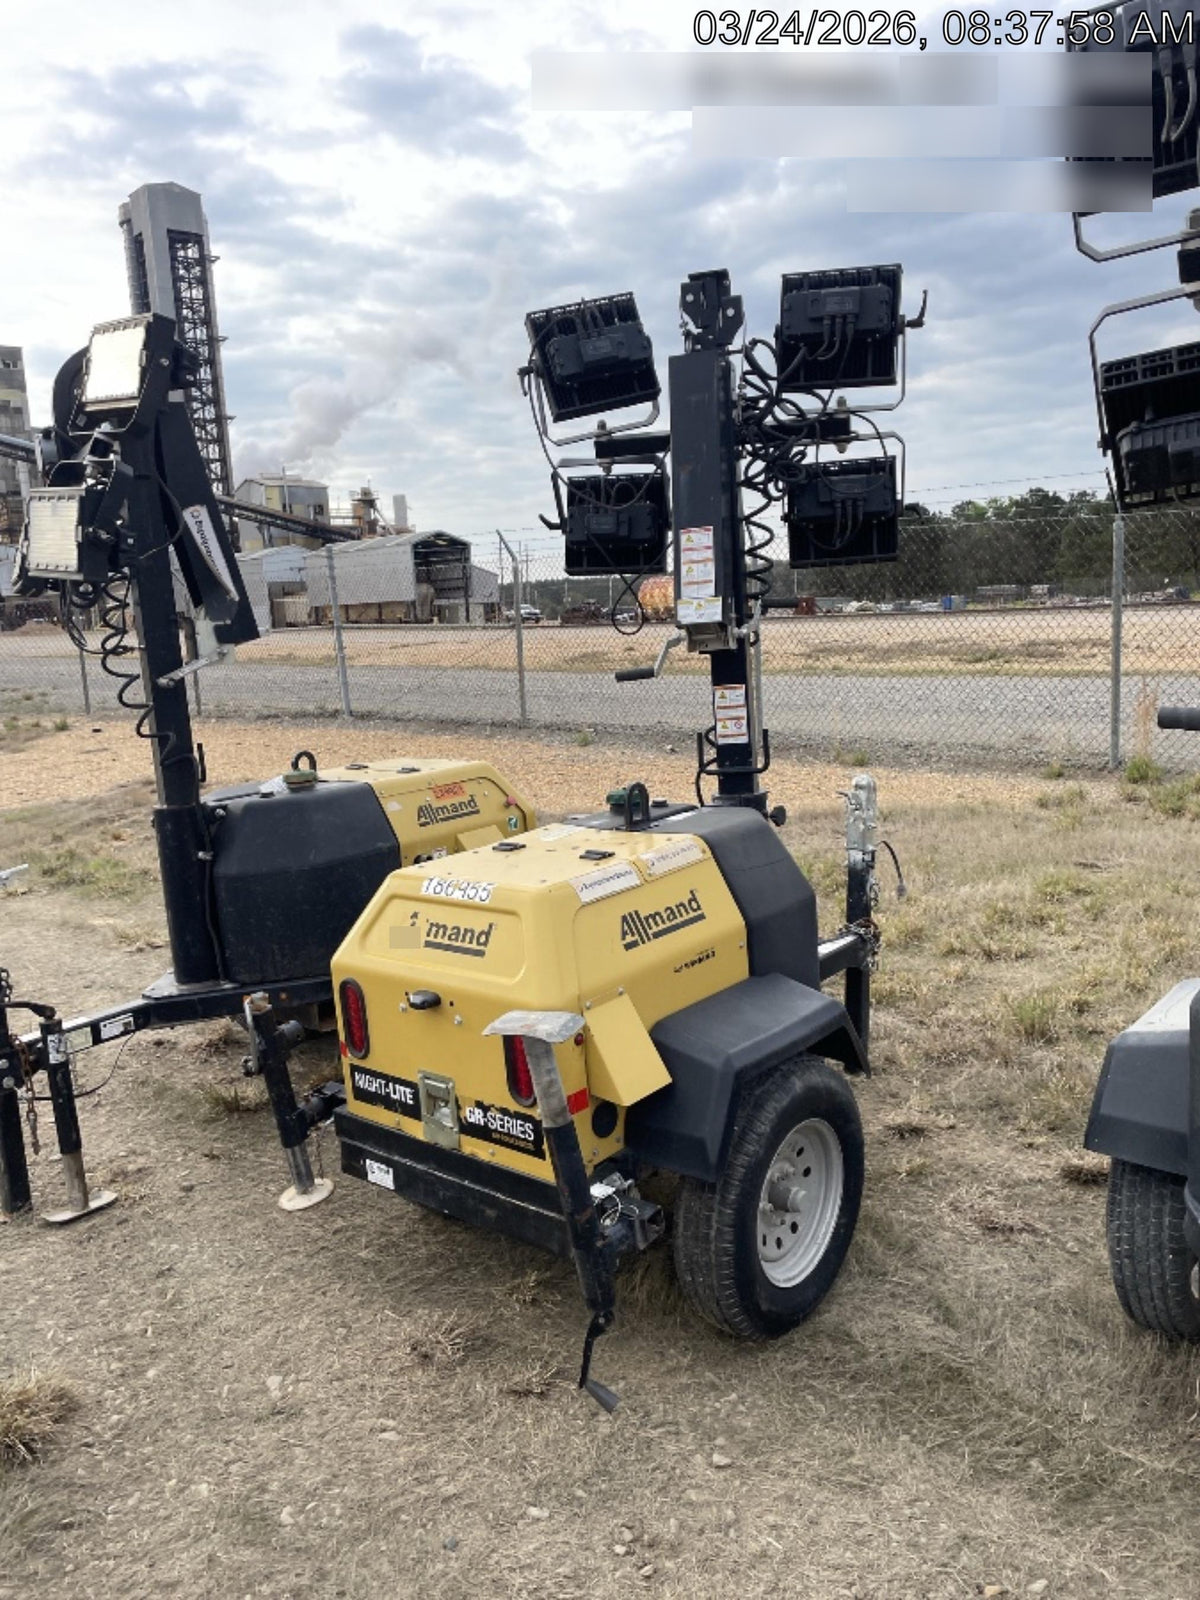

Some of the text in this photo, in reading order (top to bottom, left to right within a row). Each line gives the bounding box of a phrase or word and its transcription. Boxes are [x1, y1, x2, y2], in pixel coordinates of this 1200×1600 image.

[417, 794, 479, 825] Allmand
[620, 889, 703, 945] Allmand
[354, 1071, 415, 1105] NIGHT-LITE
[465, 1106, 535, 1141] GR-SERIES
